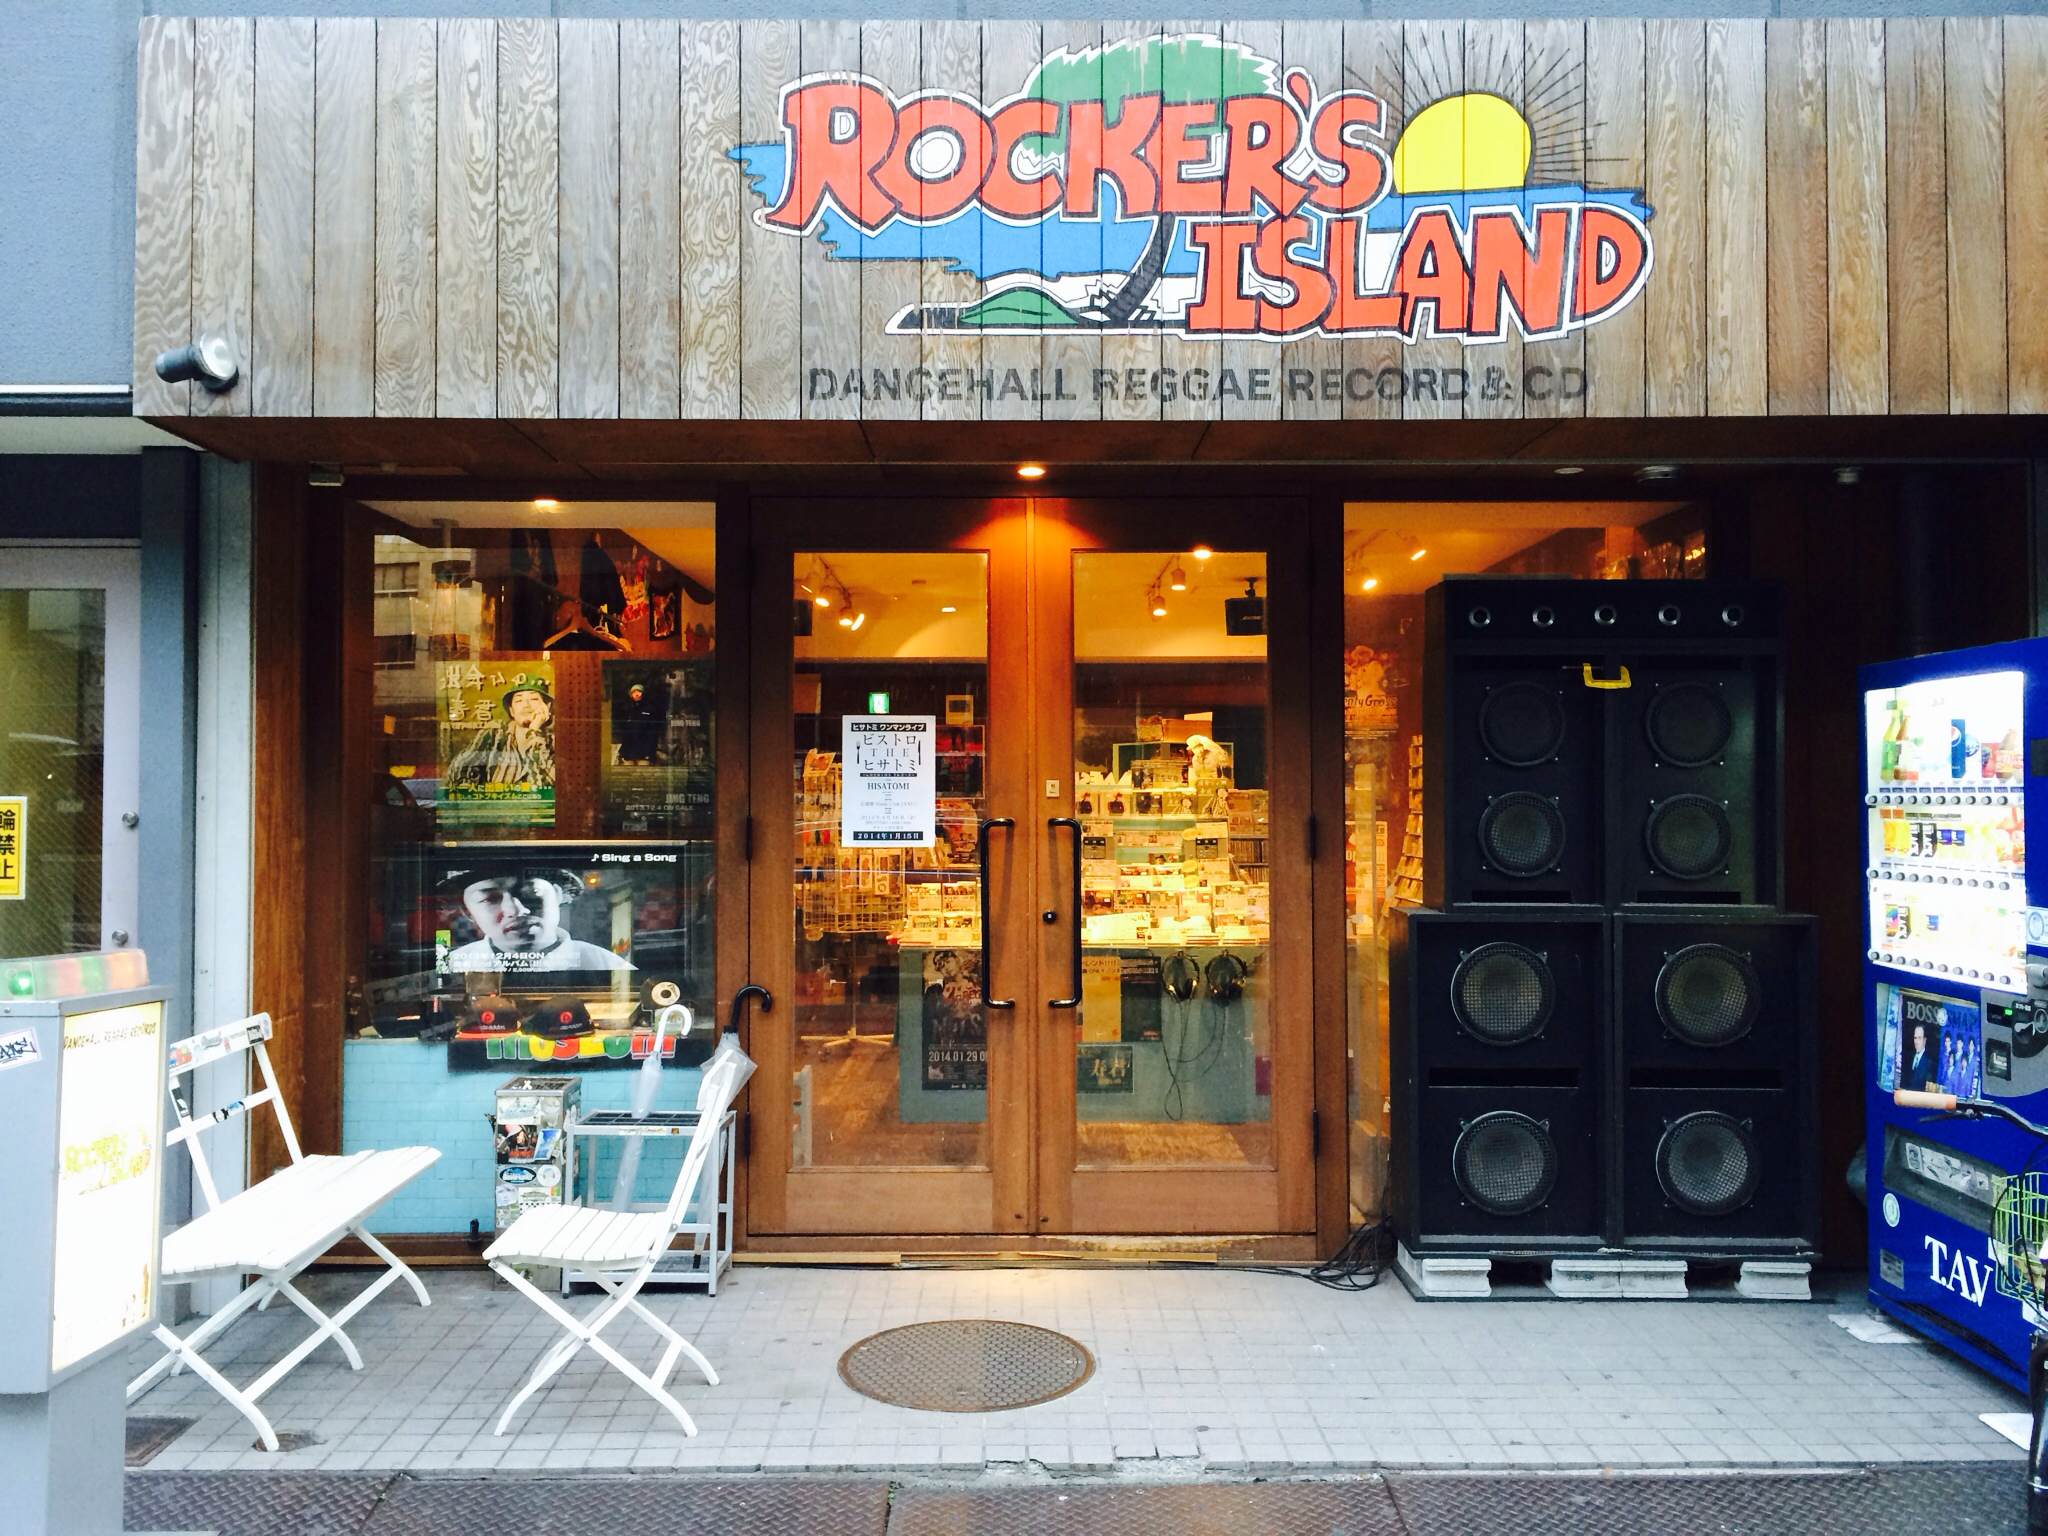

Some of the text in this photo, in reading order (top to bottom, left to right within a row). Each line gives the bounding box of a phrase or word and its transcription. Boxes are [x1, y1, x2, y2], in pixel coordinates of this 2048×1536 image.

[762, 70, 1388, 230] ROCKER'S
[1186, 203, 1650, 336] ISLAND
[809, 365, 1588, 402] DANCEHALL REGGAE RECORD & CD
[863, 734, 917, 746] ビストロ
[871, 748, 910, 757] THE
[864, 760, 918, 771] ヒサトミ
[867, 782, 910, 791] HISATOMI
[601, 853, 631, 864] Sing
[645, 853, 677, 863] Song
